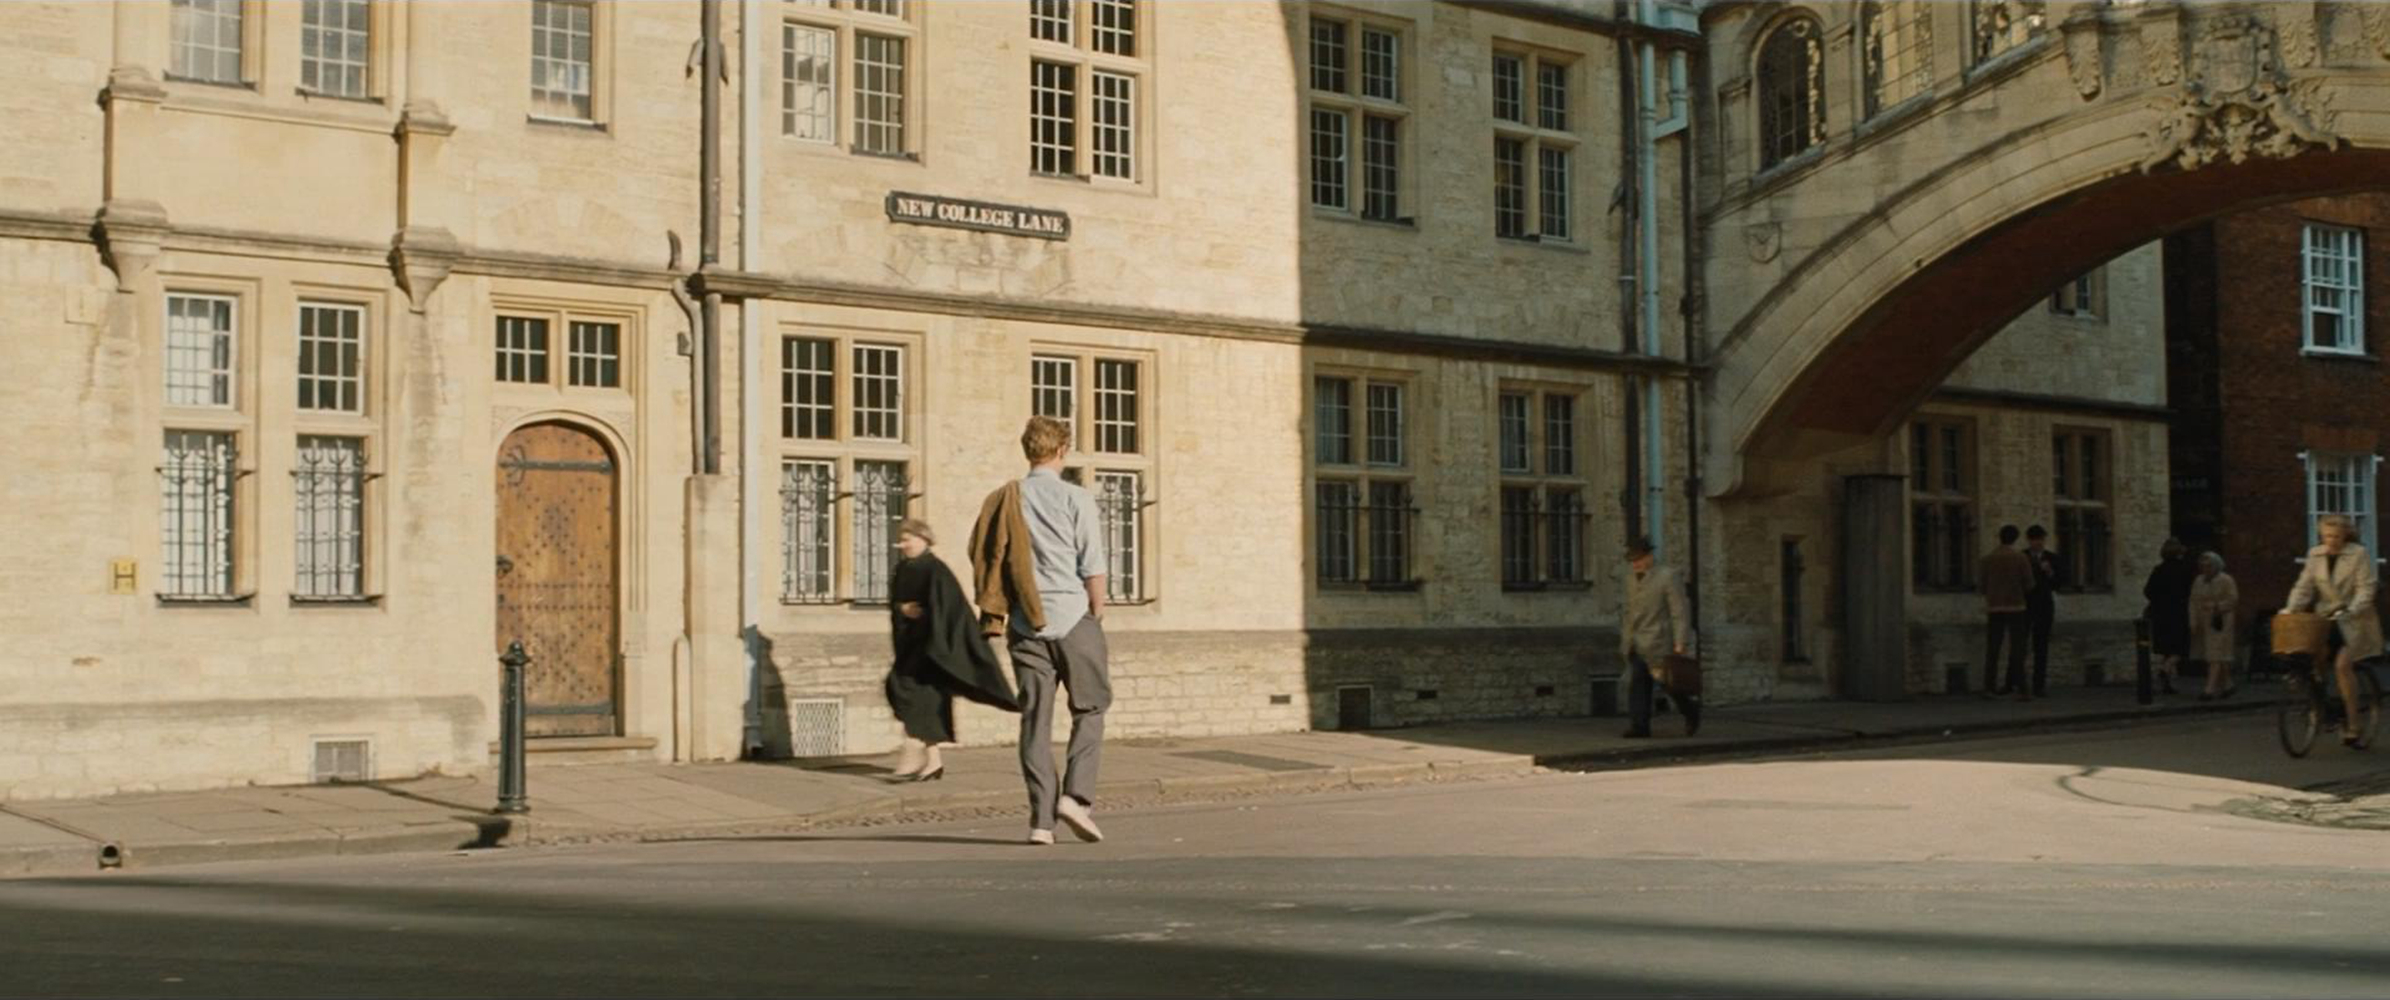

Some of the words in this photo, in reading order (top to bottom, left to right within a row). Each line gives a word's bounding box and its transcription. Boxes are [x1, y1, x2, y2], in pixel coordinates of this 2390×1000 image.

[897, 198, 934, 217] NEW
[937, 203, 1014, 228] COLLEGE
[1018, 213, 1064, 233] LANE
[113, 562, 136, 590] H
